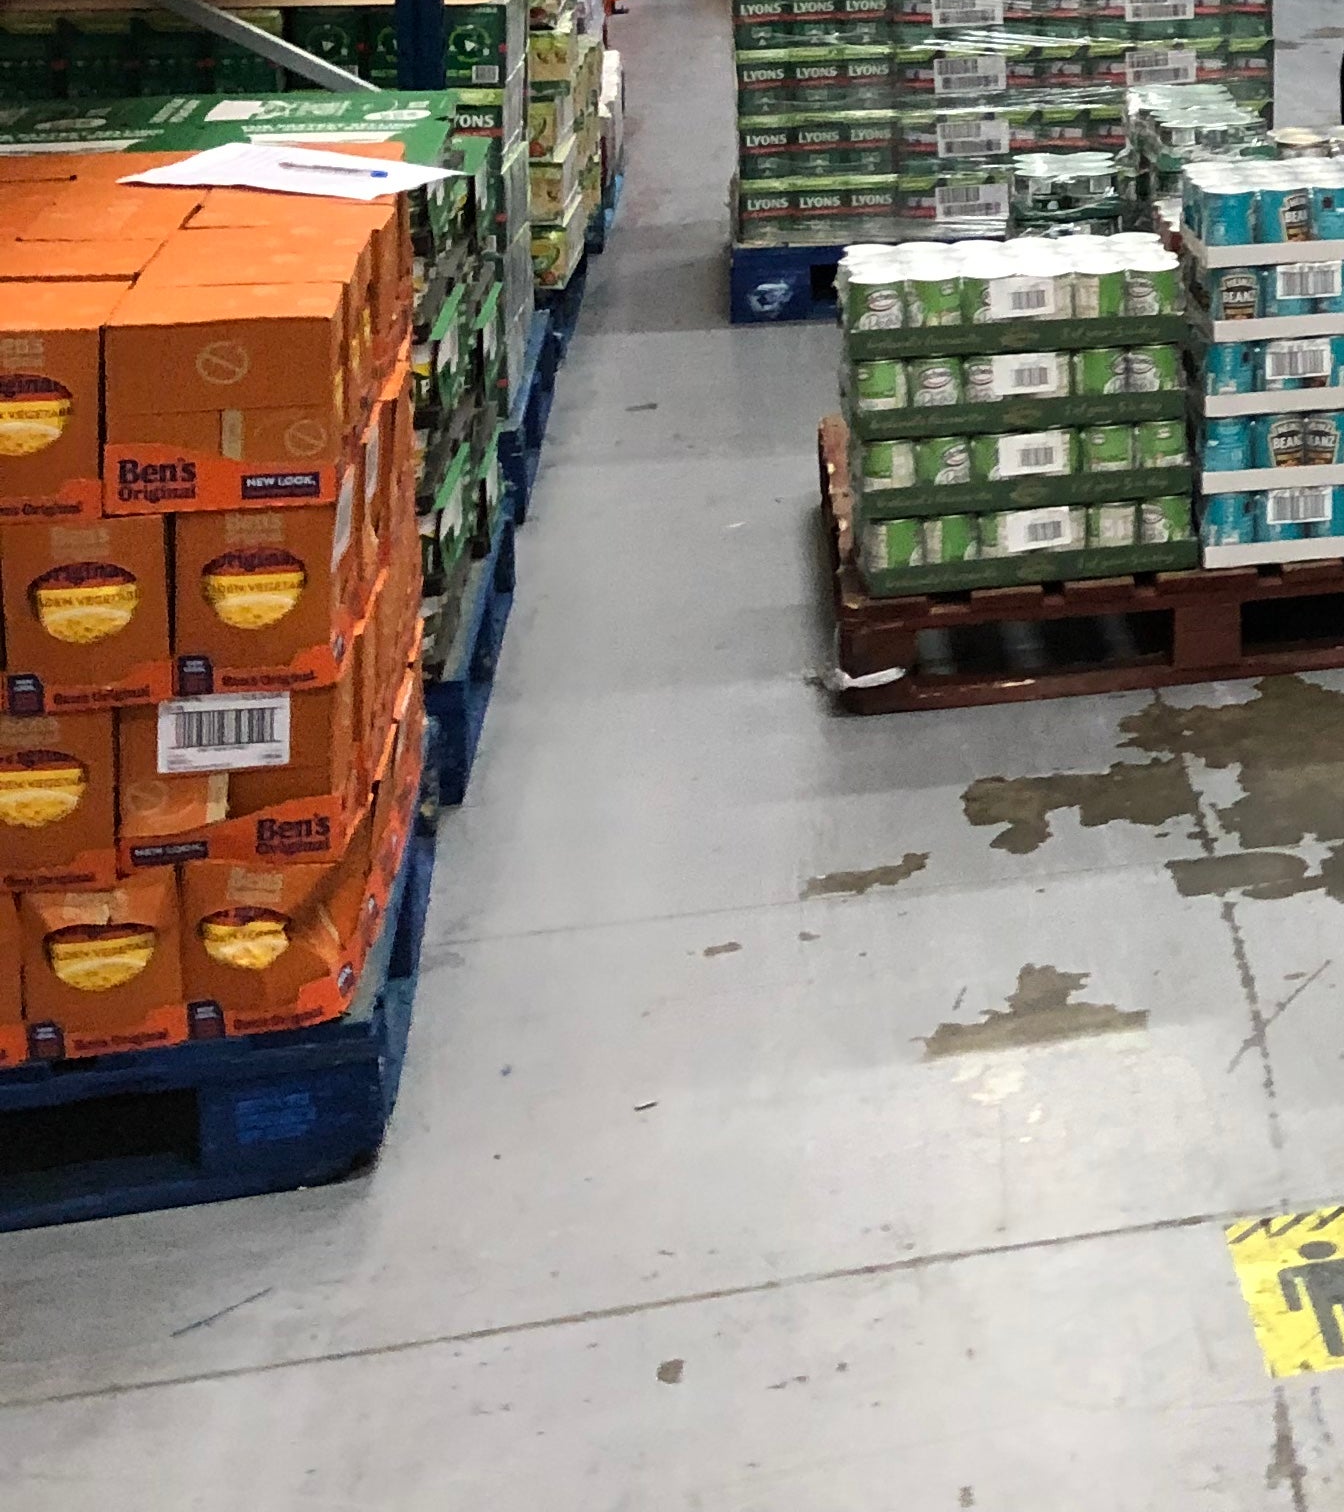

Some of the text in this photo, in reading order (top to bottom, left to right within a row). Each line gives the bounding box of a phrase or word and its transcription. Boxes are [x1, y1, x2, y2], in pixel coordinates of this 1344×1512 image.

[740, 2, 782, 16] LYONS
[793, 0, 835, 14] LYONS
[743, 63, 890, 82] LYONS LYONS LYONS
[454, 114, 496, 128] ONS
[746, 127, 892, 147] LYONS LYONS LYONS
[747, 190, 893, 211] LYONS LYONS LYONS
[1273, 437, 1302, 449] BEAN
[117, 457, 197, 485] Ben's
[246, 478, 275, 489] NEW
[117, 486, 197, 504] Original
[256, 814, 331, 840] Ben's
